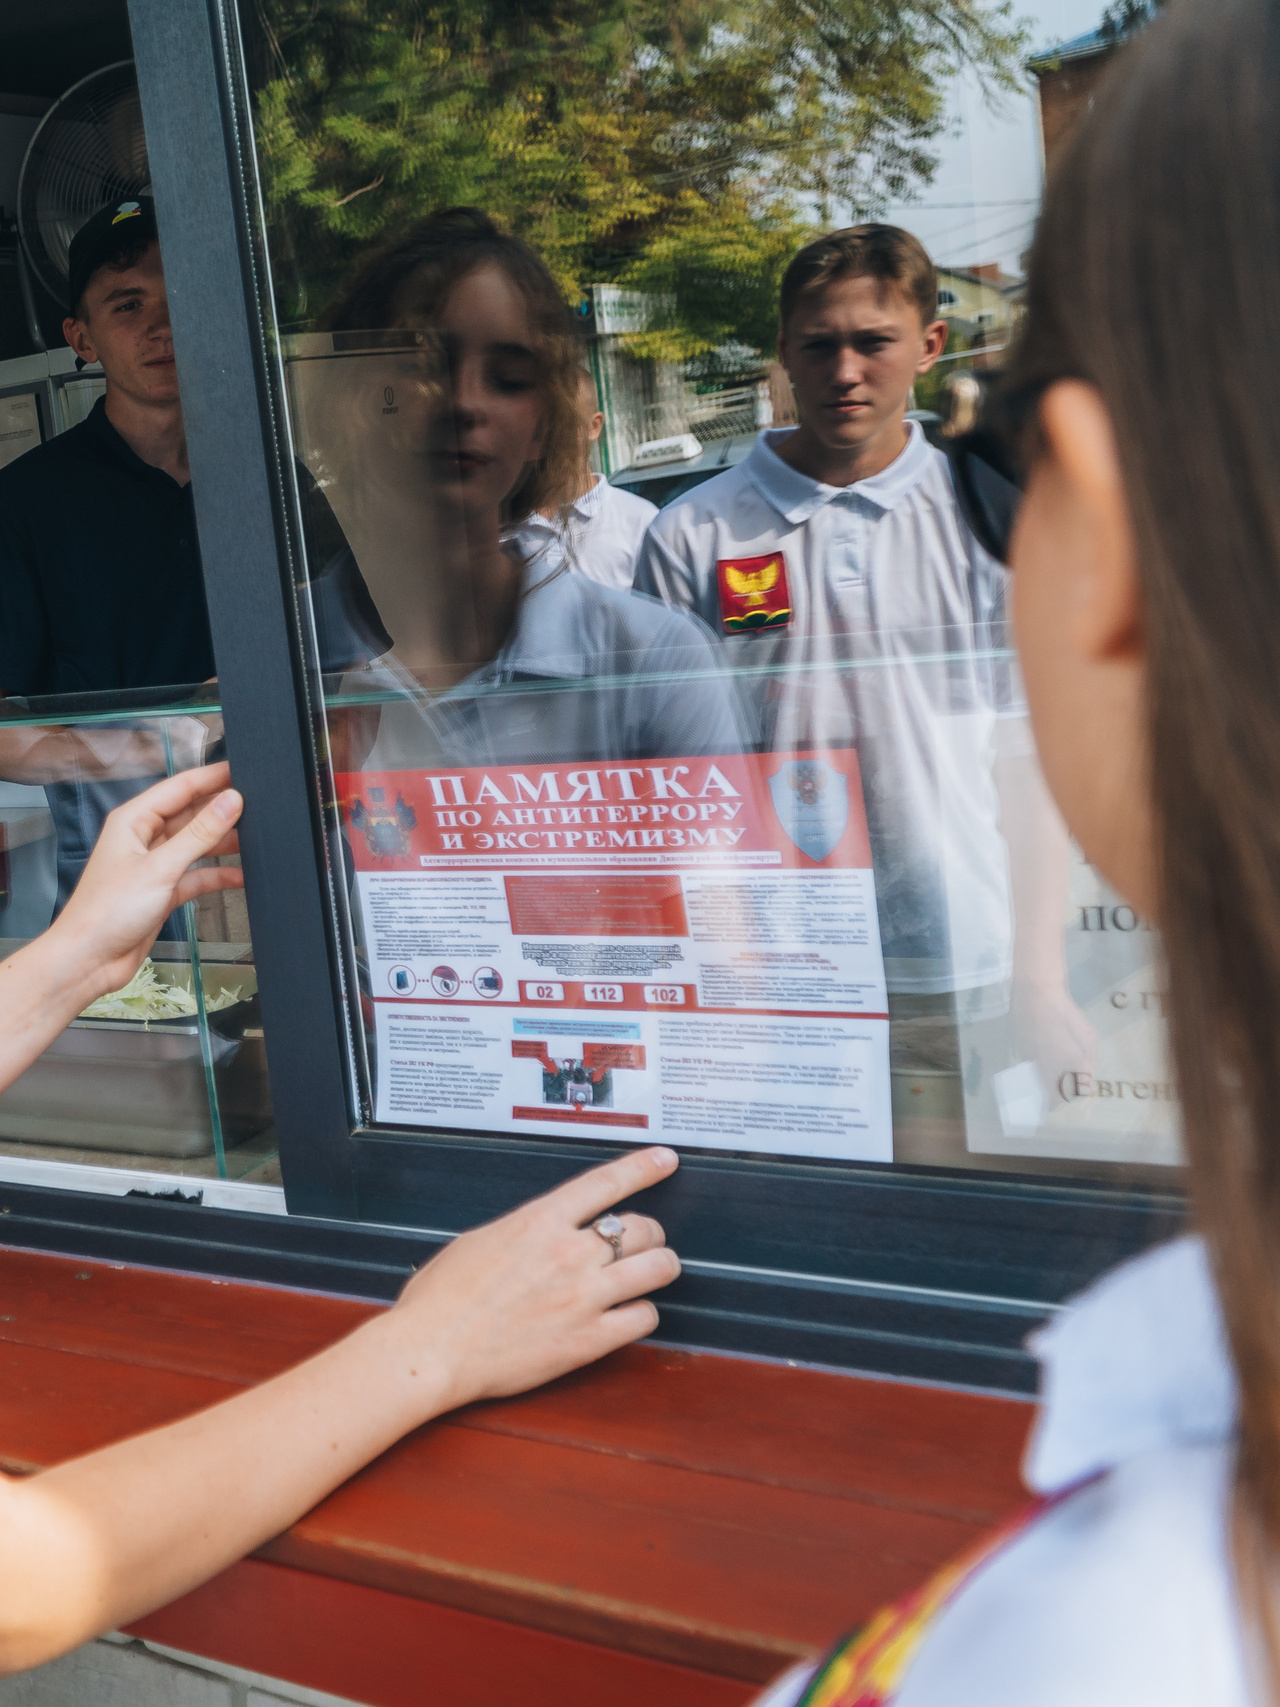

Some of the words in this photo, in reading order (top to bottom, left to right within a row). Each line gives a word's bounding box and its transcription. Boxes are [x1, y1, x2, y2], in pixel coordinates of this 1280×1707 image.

[425, 764, 742, 807] ПАМЯТКА
[434, 810, 482, 827] ПО
[492, 802, 744, 827] АНТИТЕРРОРУ
[440, 832, 466, 850] И
[473, 827, 747, 849] ЭКСТРЕМИЗМУ
[537, 986, 553, 998] 02
[591, 987, 616, 1000] 112
[651, 988, 678, 1001] 102
